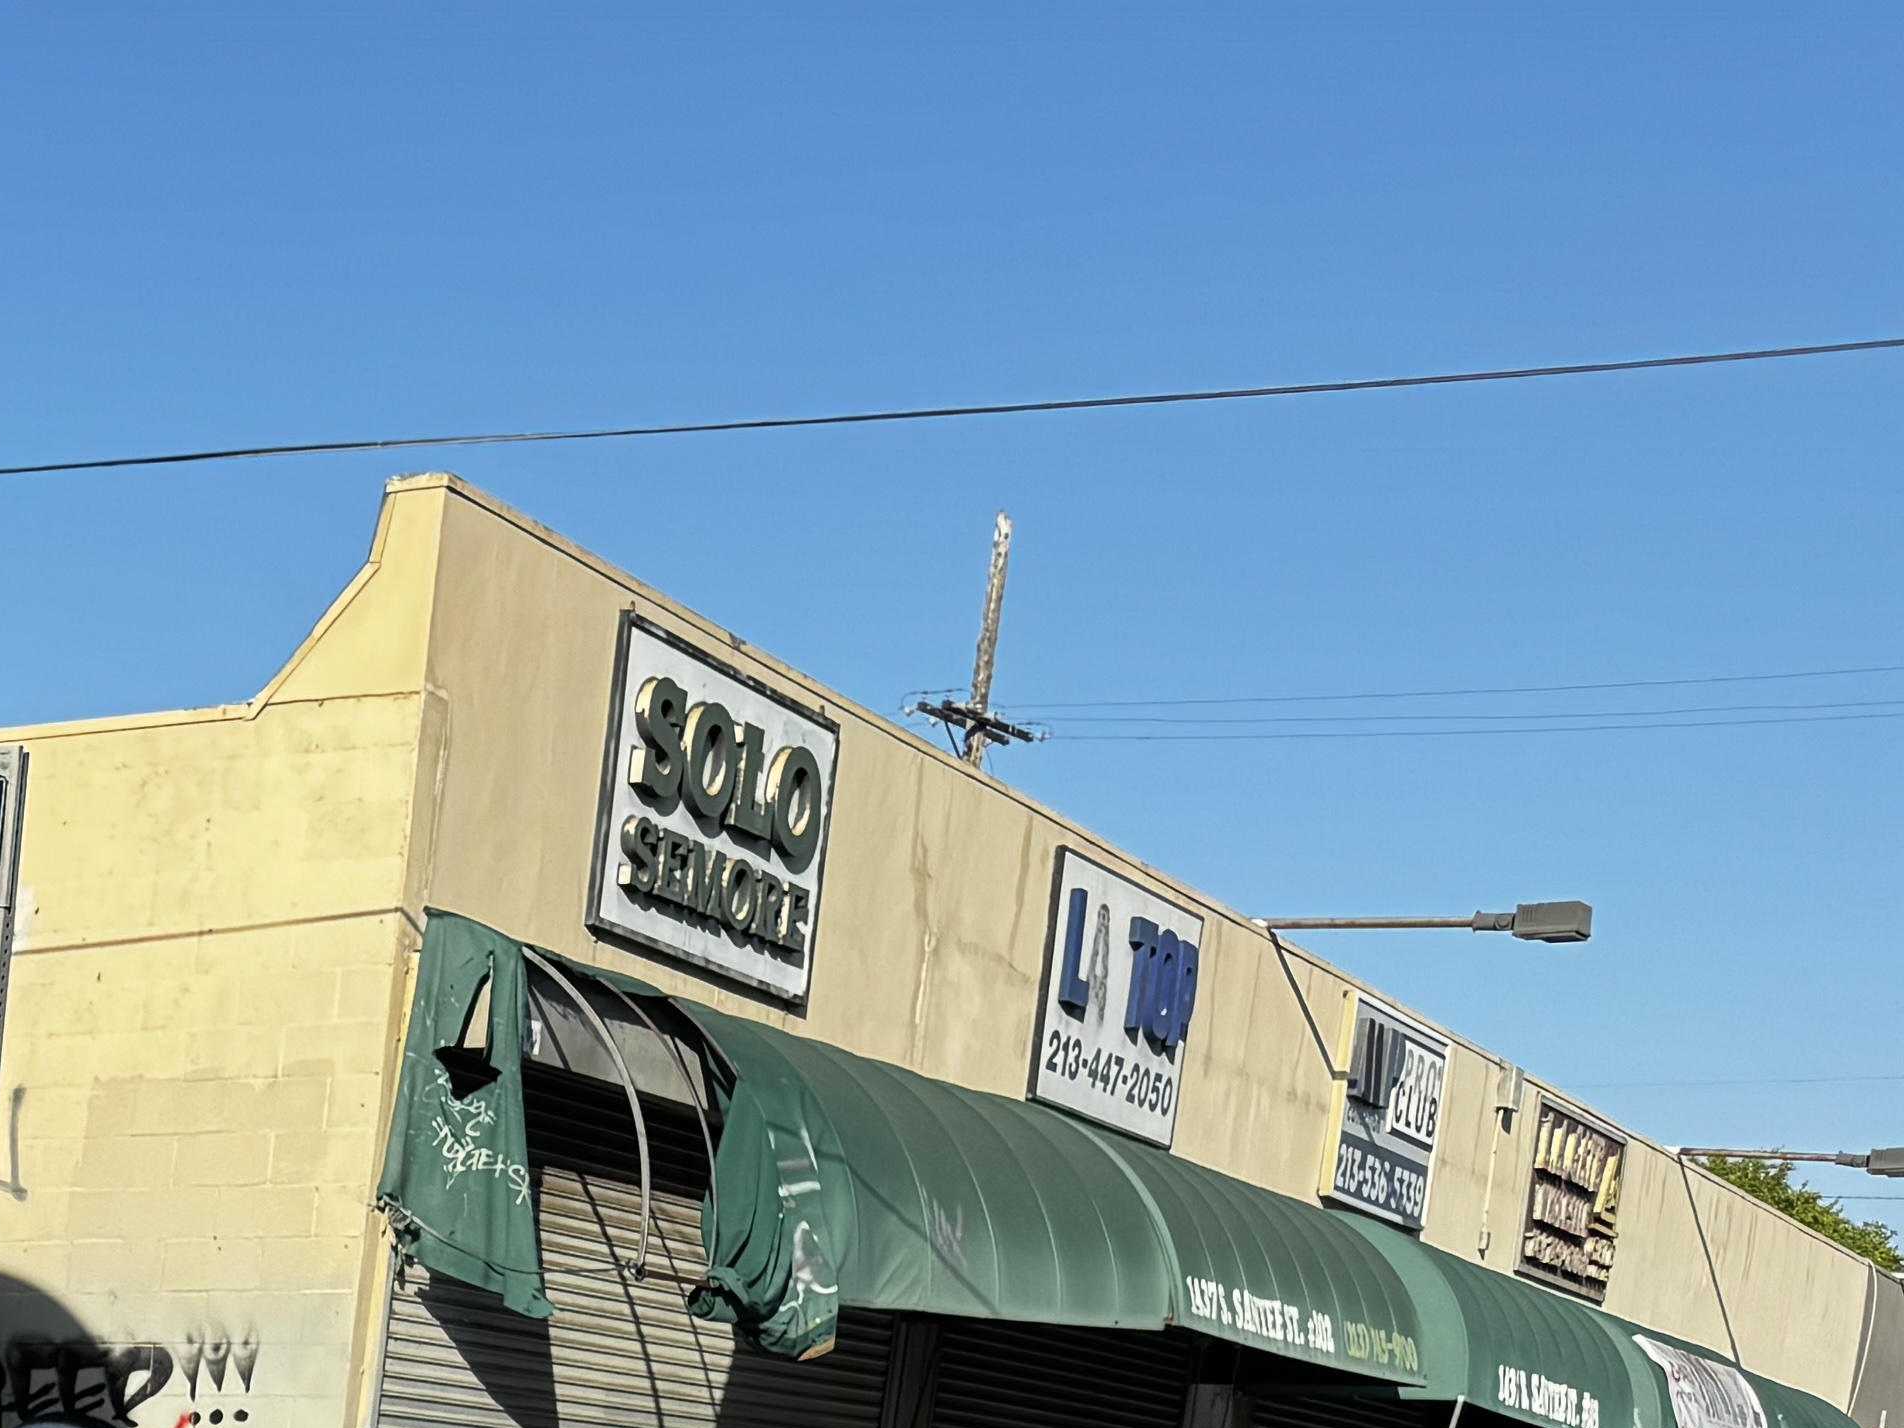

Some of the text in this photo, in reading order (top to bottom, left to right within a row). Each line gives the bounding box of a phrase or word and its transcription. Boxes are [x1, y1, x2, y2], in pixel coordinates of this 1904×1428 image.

[629, 676, 822, 866] SOLO
[618, 815, 810, 954] SEMORE
[1124, 916, 1199, 1050] TOP
[1045, 1029, 1174, 1117] 213-447-2050
[1394, 1080, 1438, 1138] CLUB
